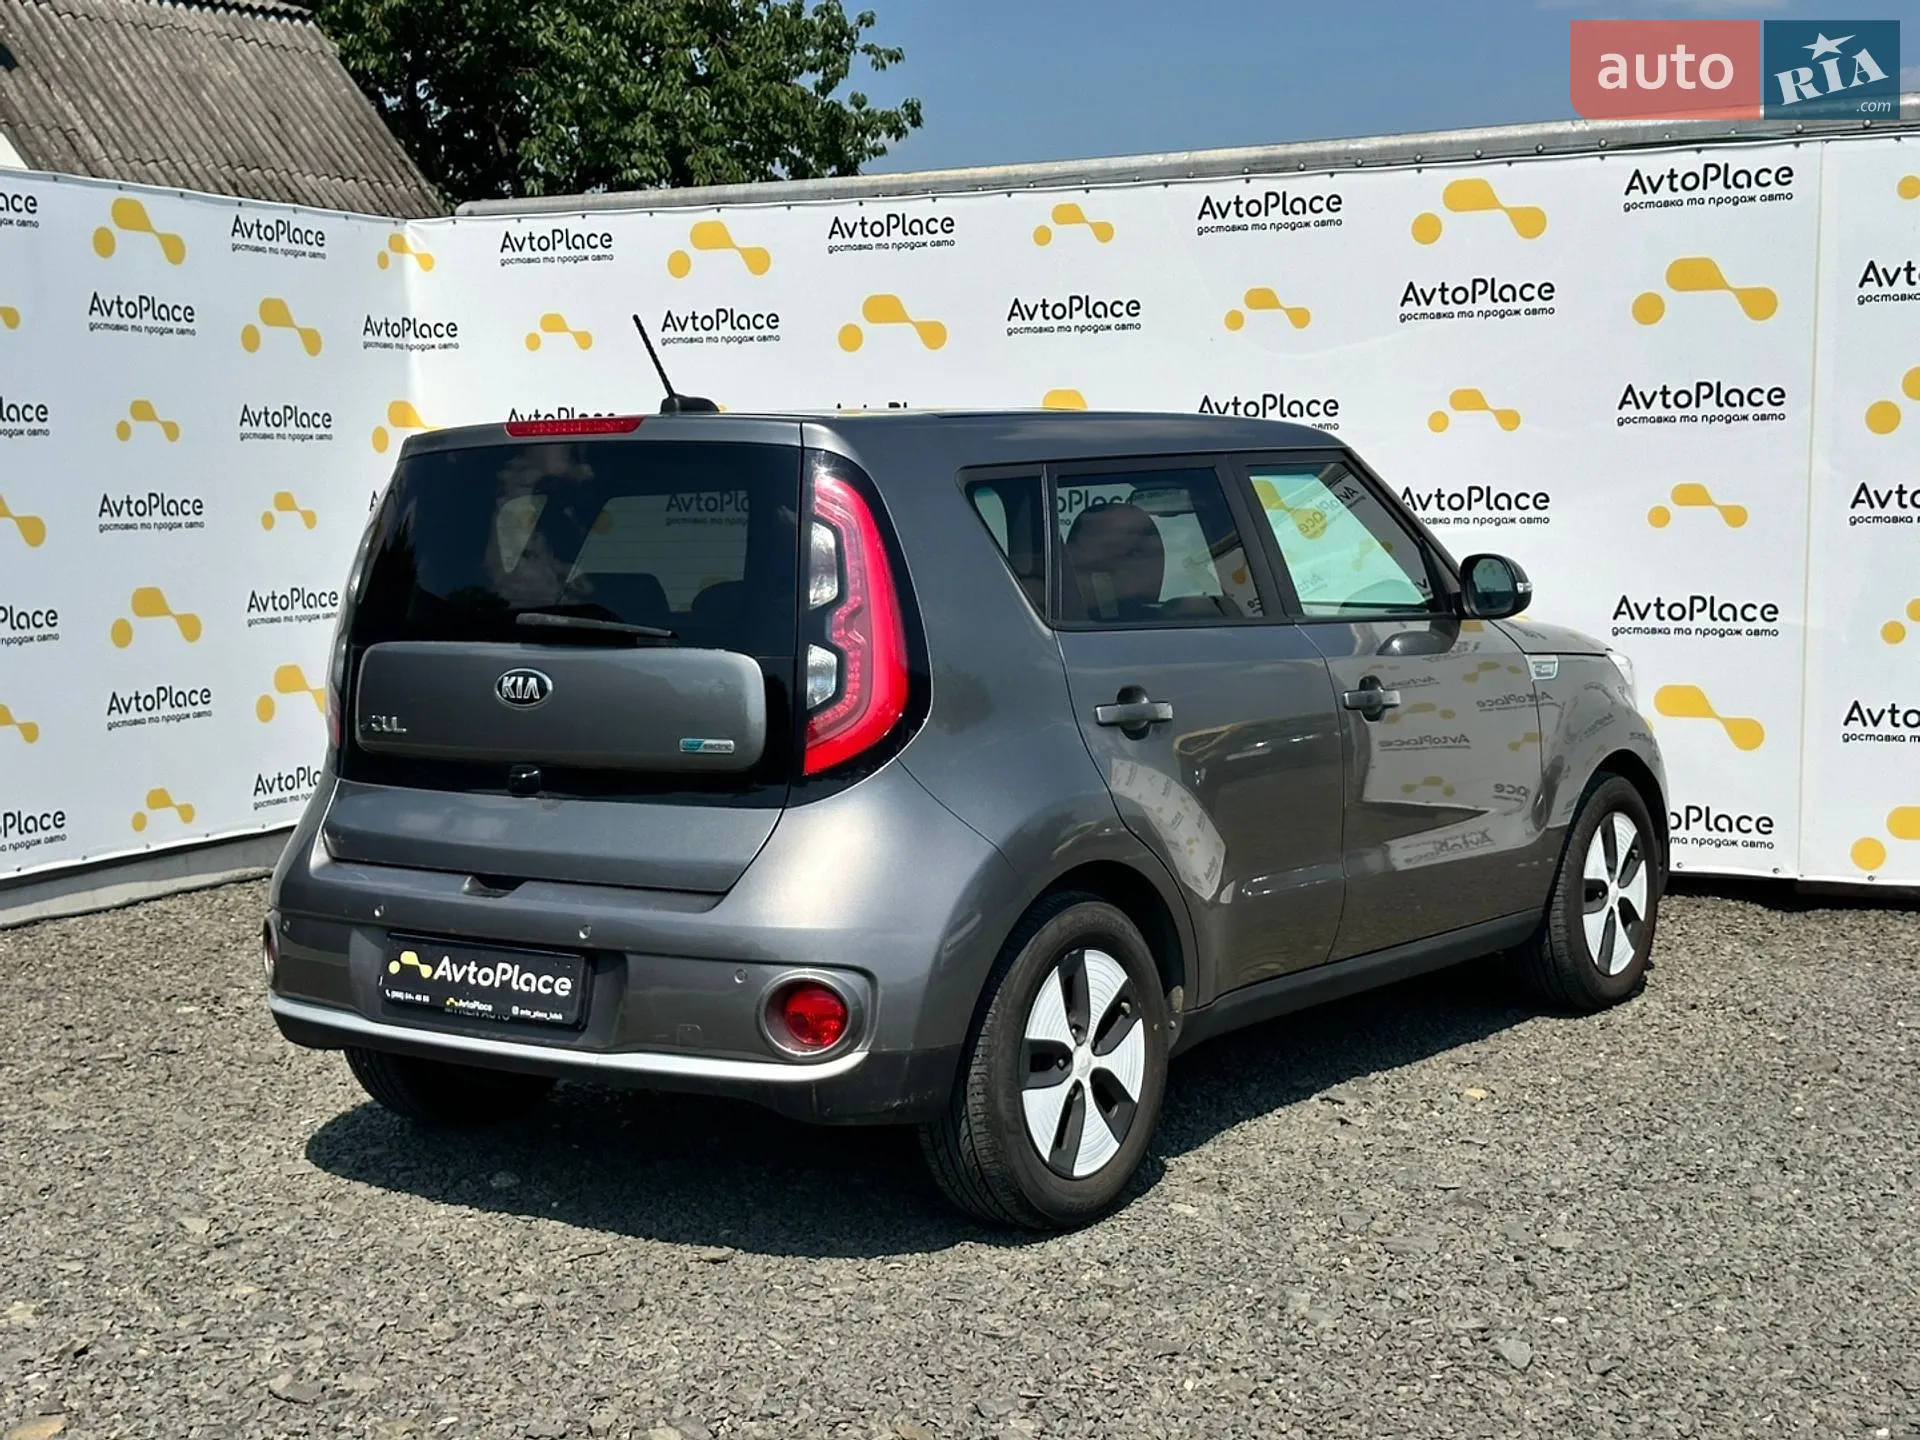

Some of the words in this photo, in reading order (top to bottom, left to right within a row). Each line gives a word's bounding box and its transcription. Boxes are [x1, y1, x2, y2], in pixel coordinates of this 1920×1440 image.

[1624, 163, 1794, 196] AvtoPlace
[1198, 191, 1342, 221] AvtoPlace
[231, 214, 325, 247] AvtoPlace
[828, 213, 955, 239] AvtoPlace
[500, 228, 613, 253] AvtoPlace
[1858, 260, 1920, 288] Avt
[1400, 277, 1555, 307] AvtoPlace
[88, 291, 195, 323] AvtoPlace
[661, 308, 780, 332] AvtoPlace
[1007, 295, 1141, 322] AvtoPlace
[363, 314, 458, 339] AvtoPlace
[1618, 381, 1786, 410] AvtoPlace
[239, 404, 332, 429] AvtoPlace
[98, 492, 204, 518] AvtoPlace
[247, 587, 338, 613] AvtoPlace
[1613, 595, 1779, 622] AvtoPlace
[107, 686, 211, 716] AvtoPlace
[502, 676, 540, 699] KIA
[0, 810, 66, 838] Place
[433, 955, 572, 997] AvtoPlace
